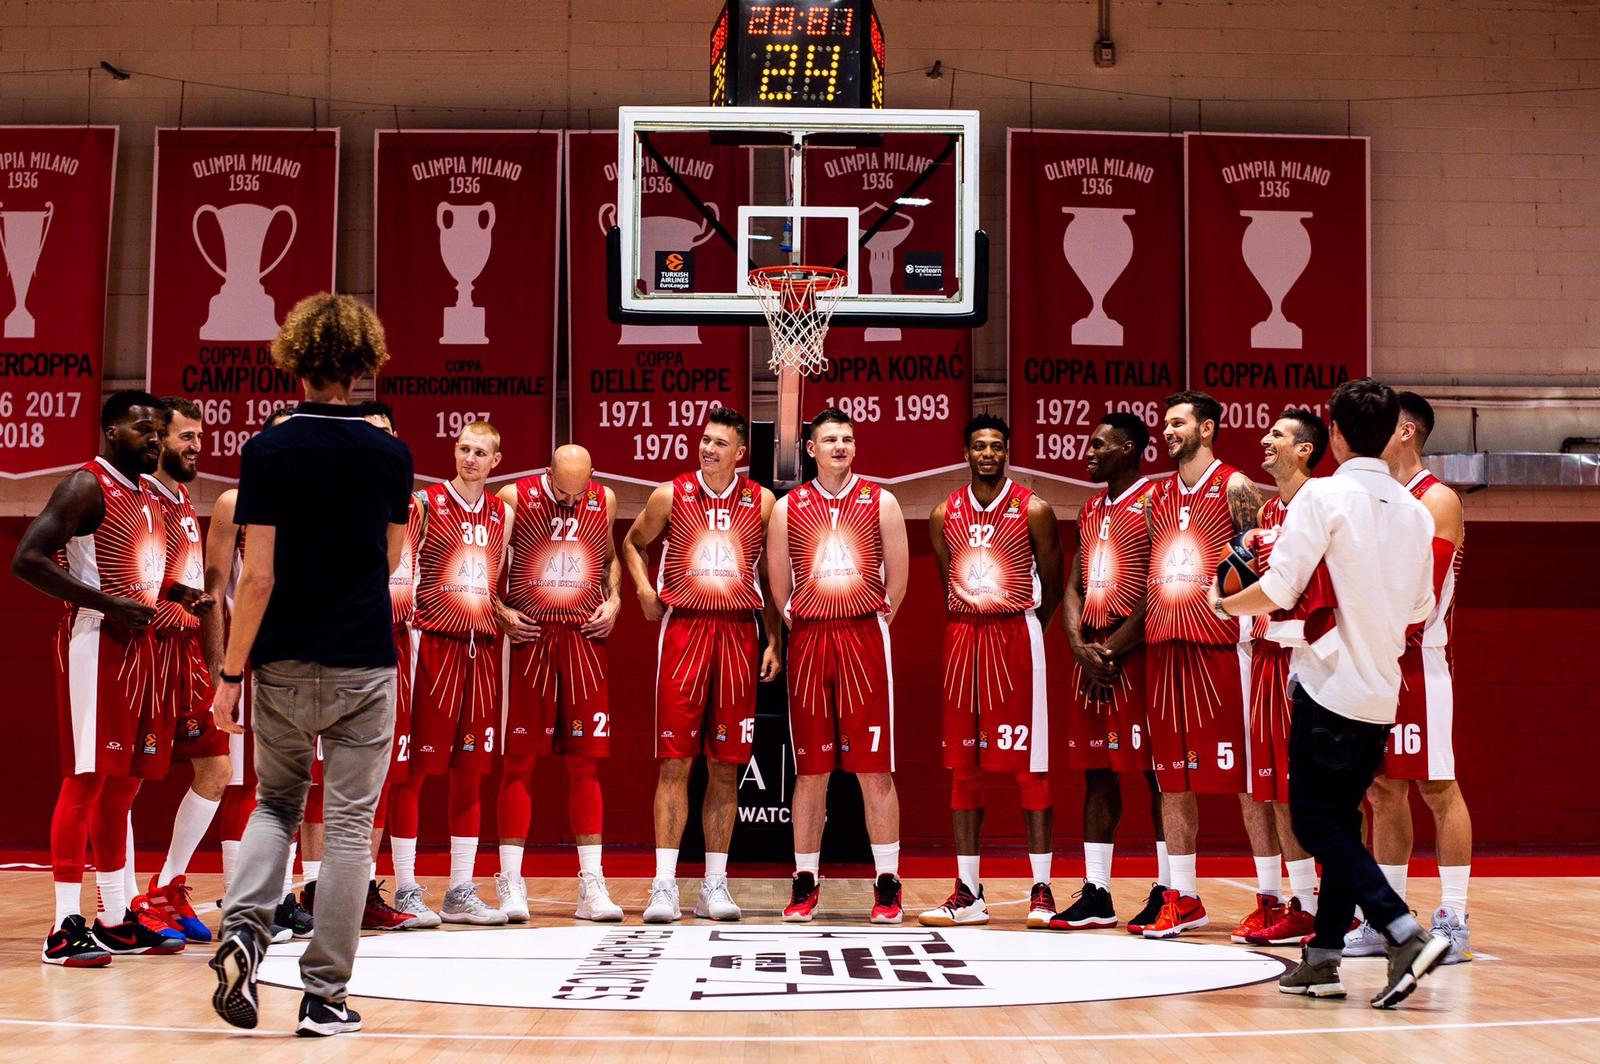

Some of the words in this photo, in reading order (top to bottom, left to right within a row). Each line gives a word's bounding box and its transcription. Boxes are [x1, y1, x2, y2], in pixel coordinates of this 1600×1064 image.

[759, 44, 841, 102] 24
[30, 152, 80, 176] MILANO
[192, 153, 246, 179] OLIMPIA
[251, 153, 302, 179] MILANO
[411, 156, 467, 181] OLIMPIA
[471, 156, 522, 181] MILANO
[603, 156, 659, 182] OLIA
[824, 152, 879, 178] OLIMPIA
[1044, 157, 1099, 181] OLIMPIA
[1103, 158, 1154, 184] MILANO
[1221, 160, 1276, 184] OLIMPIA
[1280, 160, 1331, 187] MILANO
[8, 171, 39, 189] 1936
[228, 174, 260, 192] 1936
[448, 176, 481, 194] 1936
[641, 176, 673, 194] 1936
[862, 172, 894, 190] 1936
[1081, 177, 1113, 195] 1936
[1258, 180, 1290, 198] 1936
[200, 347, 252, 365] COPPA
[446, 359, 482, 373] COPPA
[636, 351, 685, 368] COPPA
[888, 342, 964, 381] KORAĆ
[590, 368, 656, 393] DELLE
[661, 368, 731, 393] COPPE
[1024, 358, 1098, 384] COPPA
[1105, 361, 1172, 387] ITALIA
[1204, 362, 1278, 388] COPPA
[1284, 363, 1349, 389] ITALIA
[382, 376, 545, 396] INTERCONTINENTALE
[25, 391, 82, 418] 2017
[193, 399, 232, 426] 66
[245, 399, 300, 426] 19
[599, 400, 653, 427] 1971
[895, 394, 949, 421] 1993
[1036, 398, 1090, 426] 1972
[1219, 402, 1270, 429] 2016
[211, 430, 261, 457] 198
[633, 433, 689, 460] 1976
[1035, 433, 1089, 461] 1987
[141, 504, 153, 535] 1
[181, 516, 199, 543] 13
[550, 516, 579, 542] 22
[705, 507, 731, 531] 15
[829, 507, 840, 531] 7
[1099, 515, 1111, 541] 6
[1179, 505, 1190, 531] 5
[461, 521, 488, 547] 30
[968, 523, 995, 548] 32
[592, 711, 610, 738] 2
[739, 717, 755, 744] 15
[997, 724, 1029, 751] 32
[1131, 723, 1141, 750] 6
[868, 726, 881, 752] 7
[1390, 723, 1421, 755] 16
[1217, 741, 1234, 770] 5
[1258, 768, 1273, 777] EA7
[738, 806, 793, 823] WATC
[551, 929, 674, 1001] FRAGRANCES
